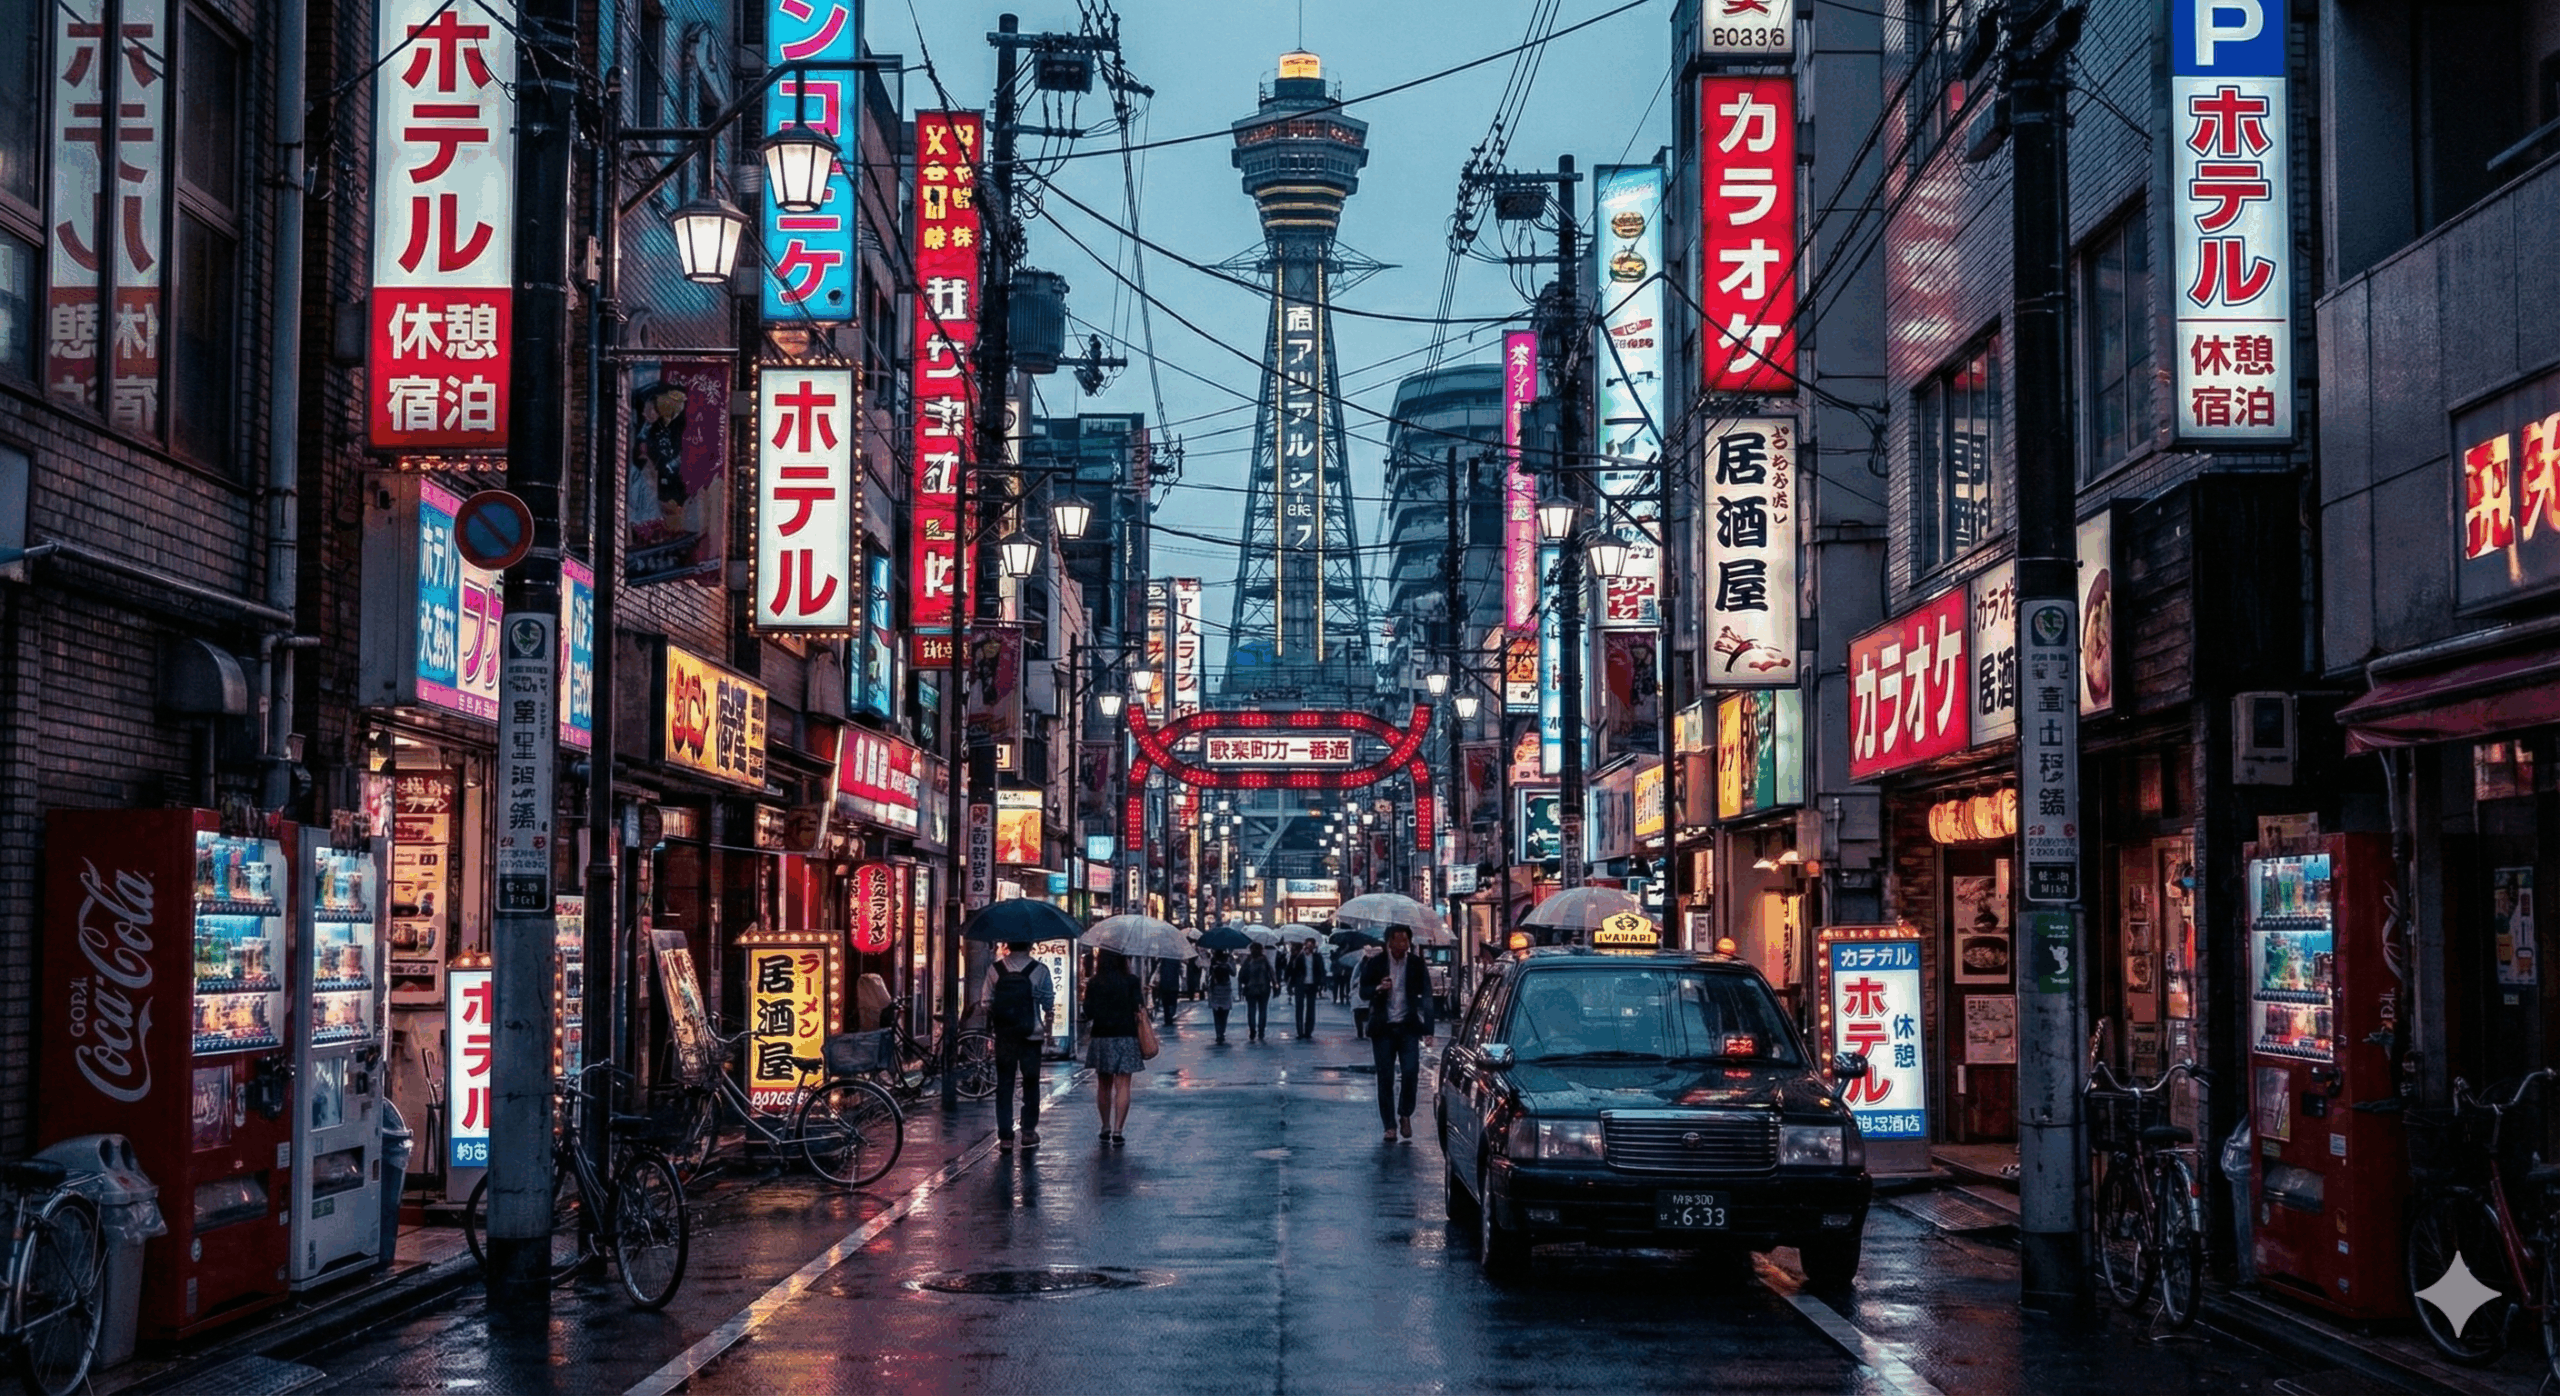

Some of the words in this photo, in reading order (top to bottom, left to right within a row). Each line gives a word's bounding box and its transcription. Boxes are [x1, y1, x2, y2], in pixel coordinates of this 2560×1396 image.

[2195, 0, 2264, 65] P
[397, 10, 494, 274] ホテル
[2188, 87, 2274, 306] ホテル
[1717, 92, 1782, 374] カラオケ
[388, 302, 499, 360] 休憩
[2190, 334, 2275, 377] 休憩
[387, 374, 498, 432] 宿泊
[2190, 386, 2275, 427] 宿泊
[771, 380, 839, 617] ホテル
[1715, 431, 1769, 613] 居酒屋
[1854, 613, 1962, 763] カラオケ
[76, 856, 154, 1102] Coca-Cola
[756, 954, 795, 1081] 居酒屋
[798, 953, 820, 1039] ラーメン
[1844, 975, 1892, 1103] ホテル
[1893, 1013, 1916, 1068] 休憩
